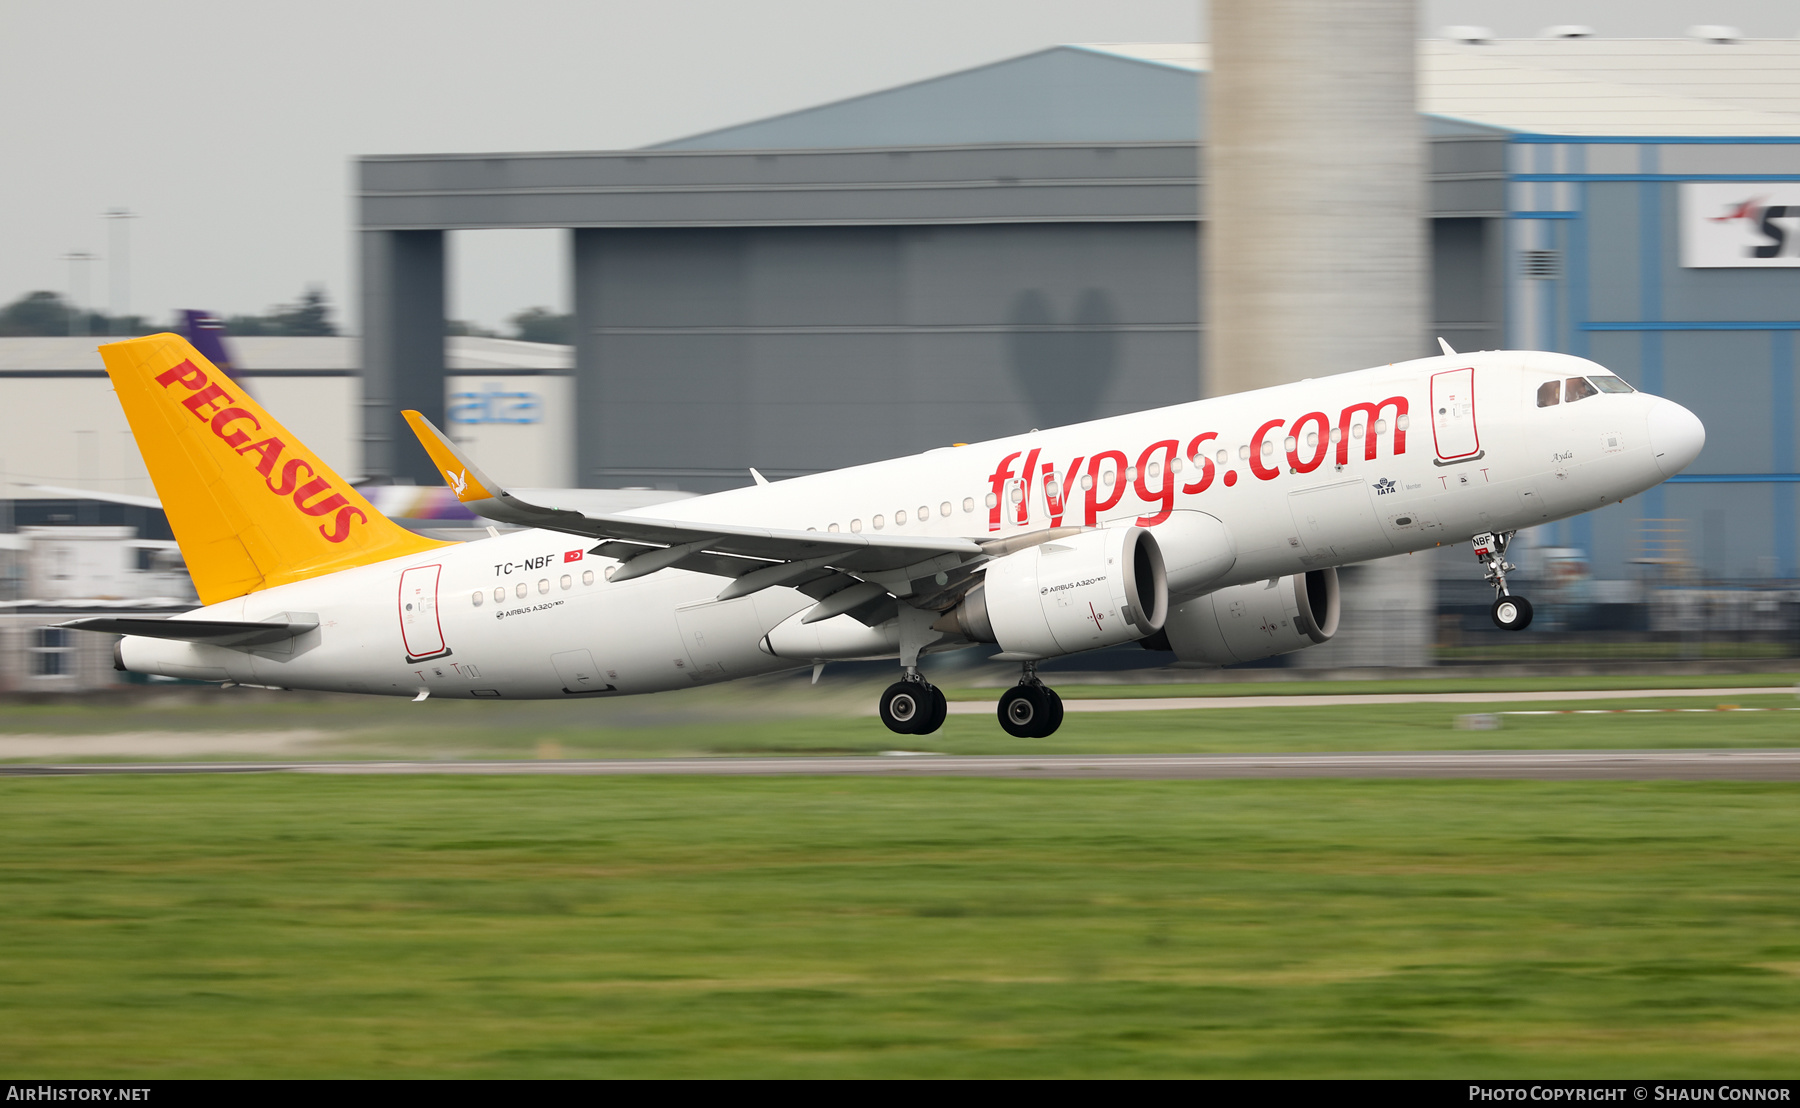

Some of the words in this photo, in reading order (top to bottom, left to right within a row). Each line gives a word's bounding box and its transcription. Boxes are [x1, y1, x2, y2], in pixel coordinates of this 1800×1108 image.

[1744, 205, 1800, 258] S
[155, 358, 367, 543] PEGASUS
[1551, 450, 1573, 463] Ayda
[988, 395, 1409, 532] flypgs.com
[1377, 487, 1396, 496] IATA
[1406, 482, 1421, 490] Member
[1472, 535, 1491, 548] NBF
[494, 554, 555, 576] TC-NBF
[1049, 583, 1074, 593] AIRBUS
[505, 606, 531, 618] AIRBUS
